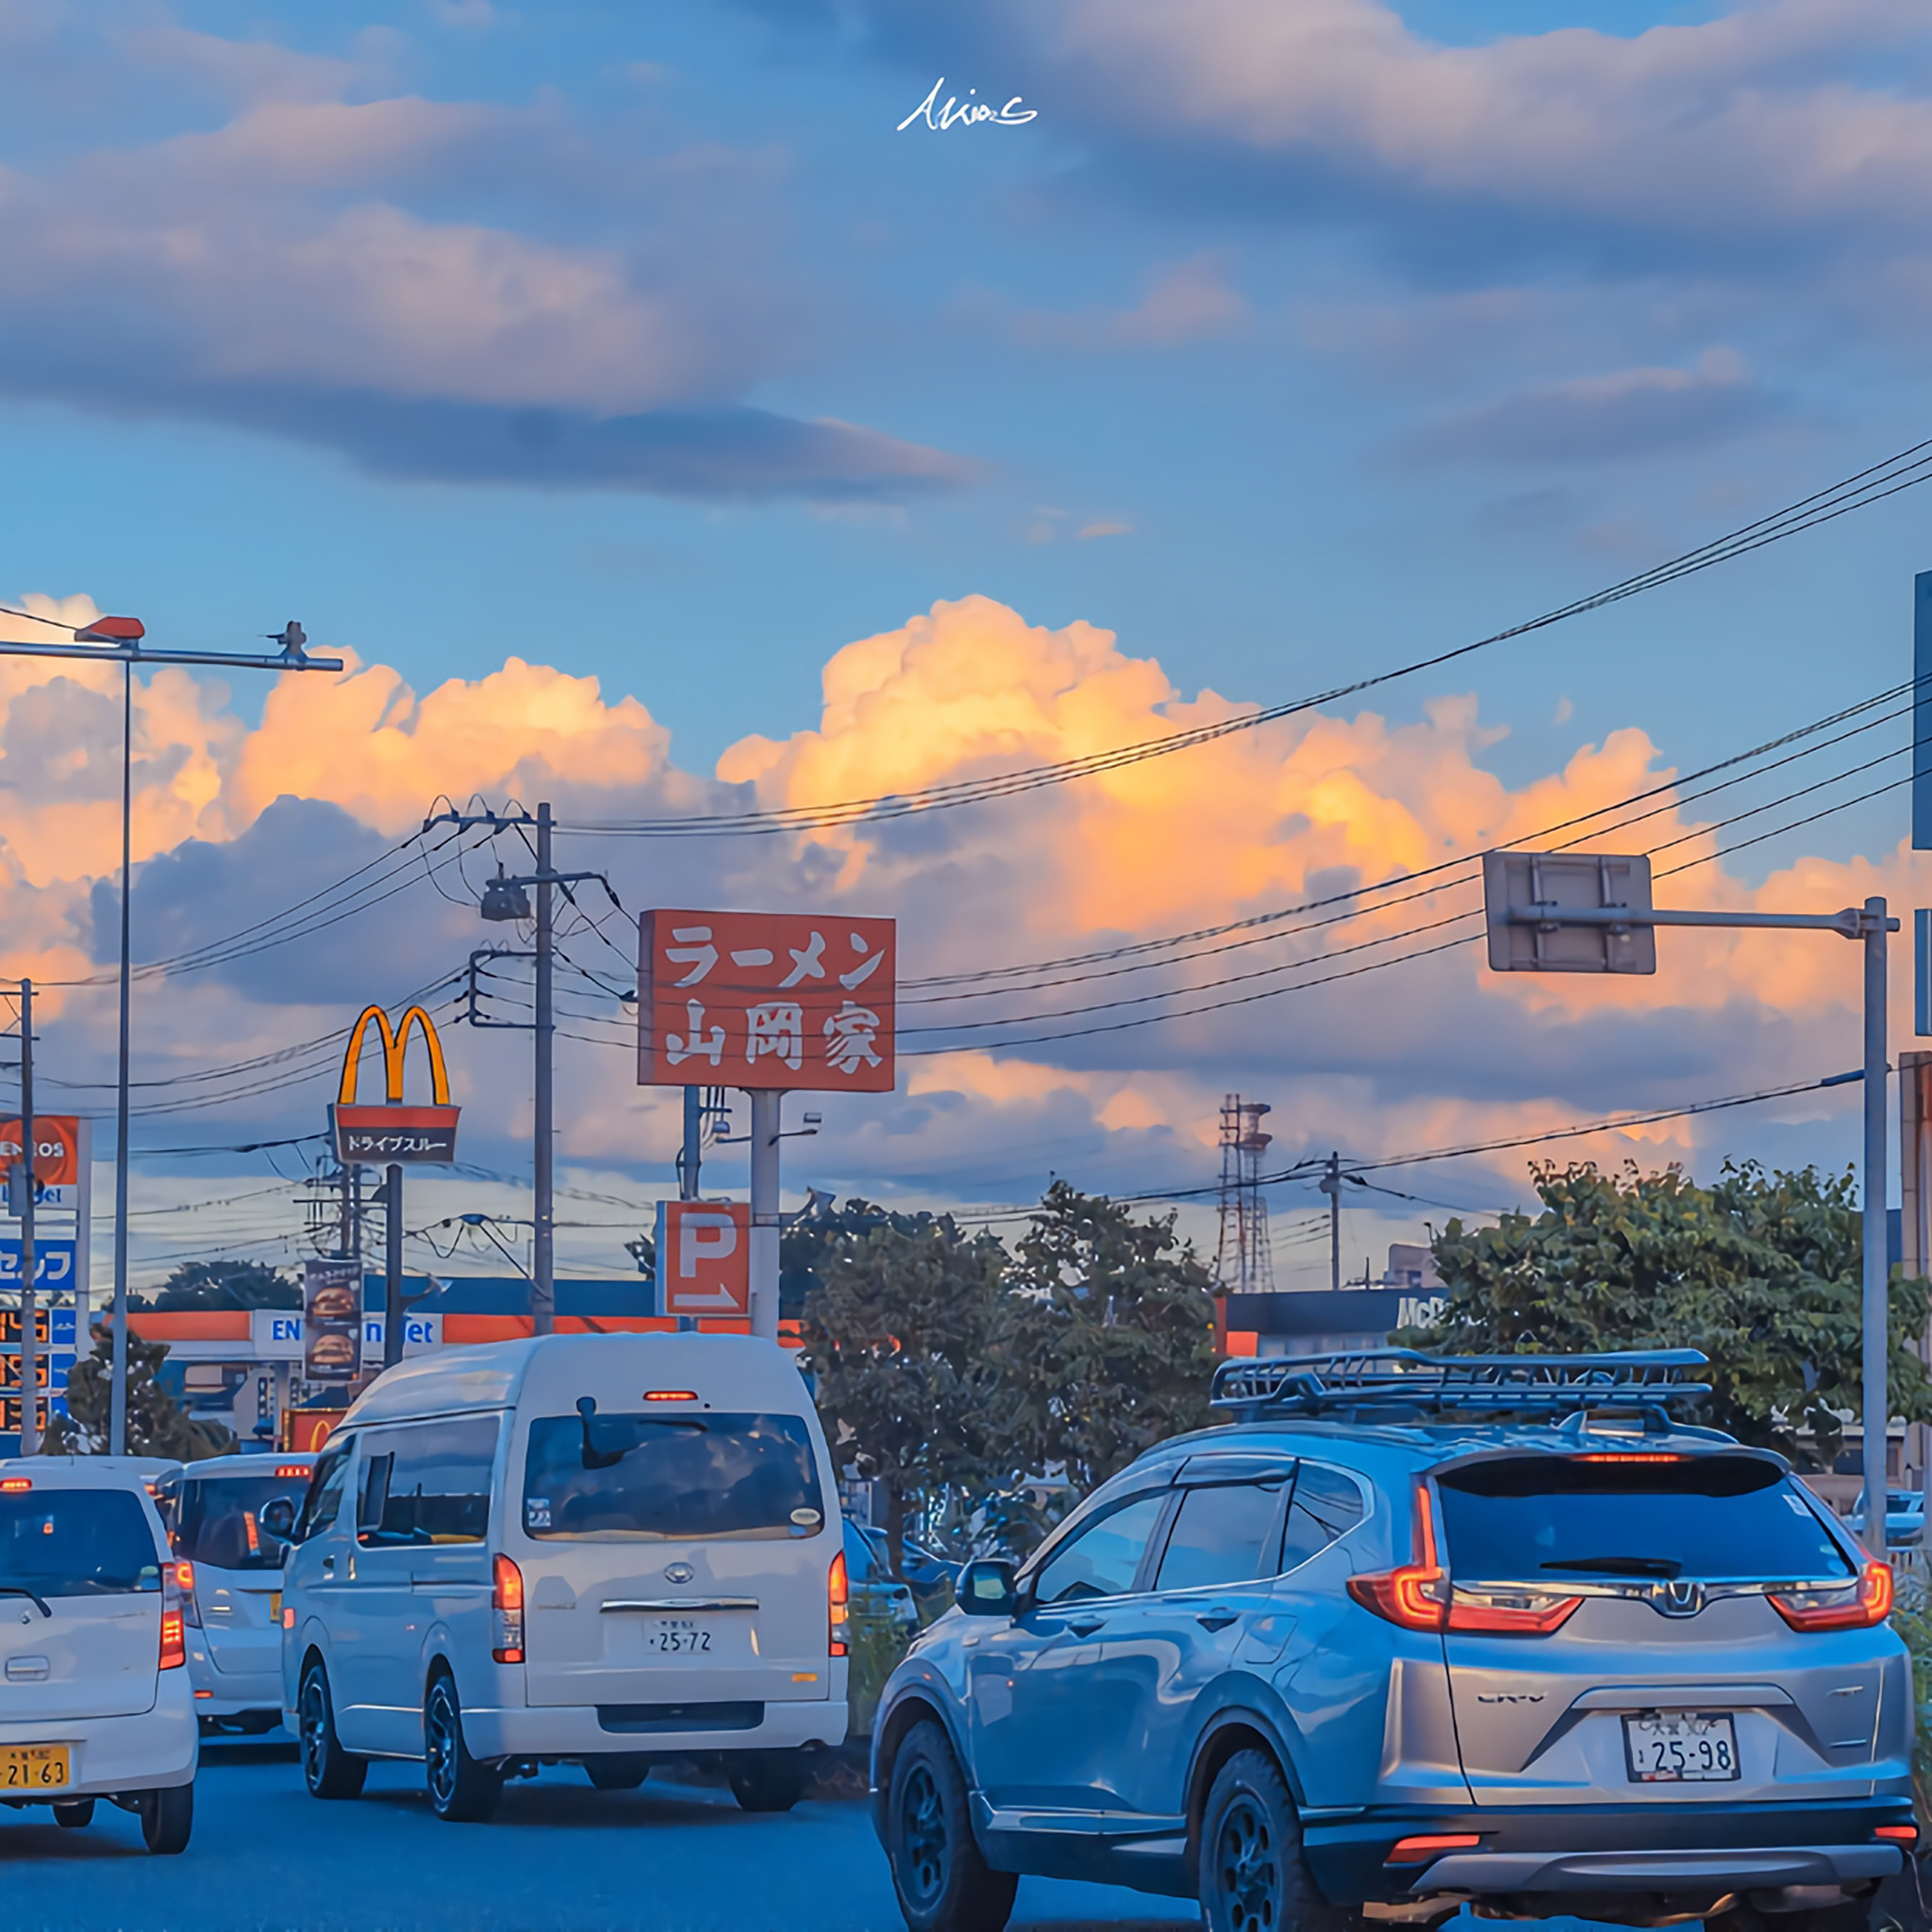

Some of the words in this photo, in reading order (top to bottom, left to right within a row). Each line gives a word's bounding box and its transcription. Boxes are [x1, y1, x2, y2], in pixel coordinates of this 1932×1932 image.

[665, 925, 885, 990] ラーメン
[666, 998, 883, 1074] 山岡家
[0, 1141, 64, 1158] ENOS
[679, 1212, 737, 1278] P
[1652, 1740, 1731, 1772] 25-98
